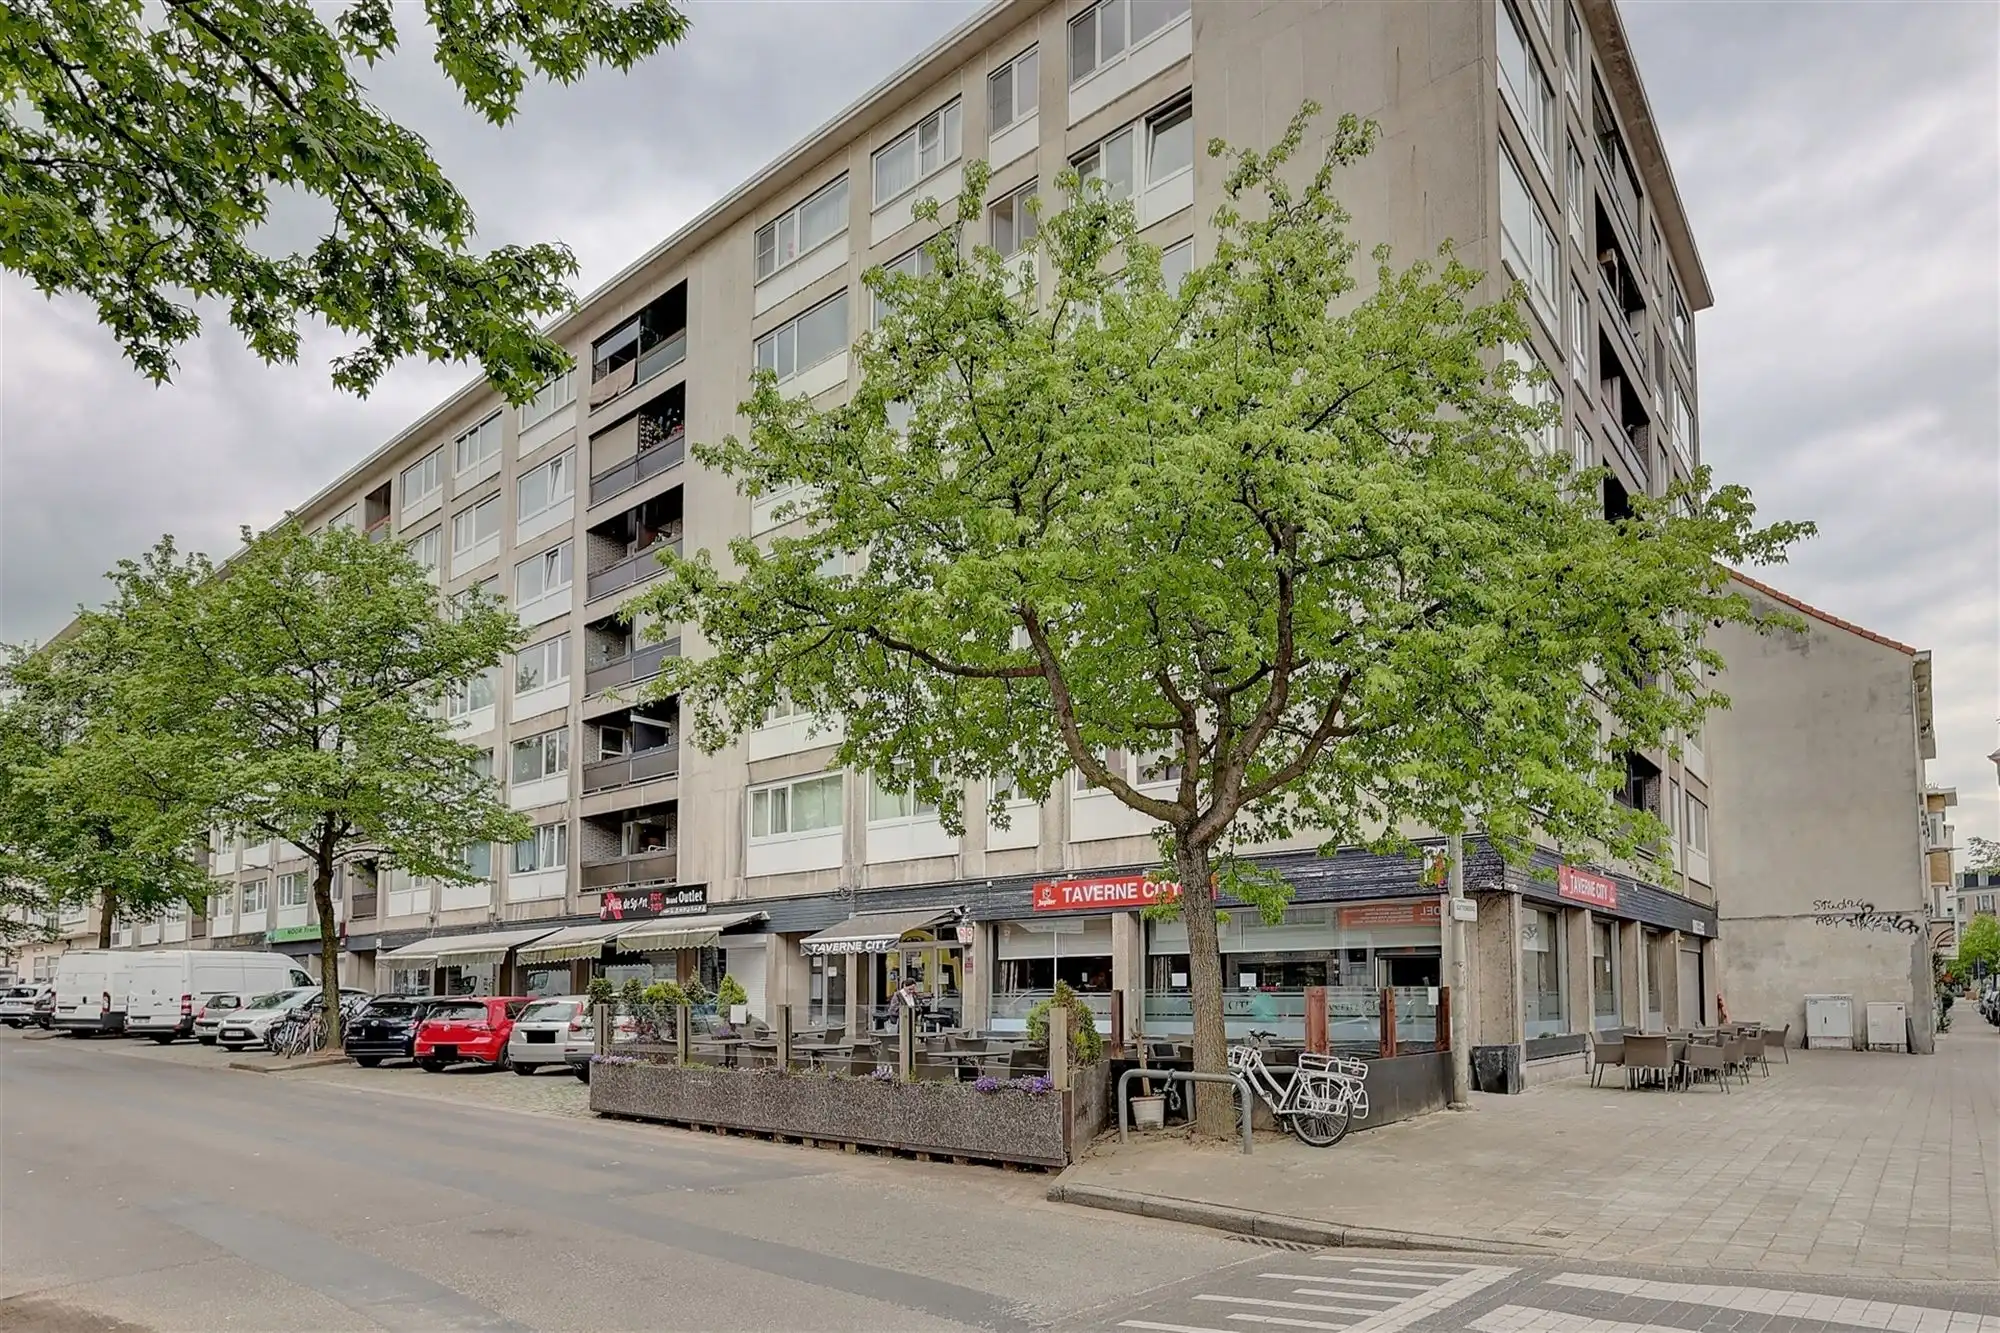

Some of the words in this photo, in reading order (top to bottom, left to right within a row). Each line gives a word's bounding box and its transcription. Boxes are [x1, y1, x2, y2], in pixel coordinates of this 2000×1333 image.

[679, 889, 703, 903] Outlet
[1062, 882, 1138, 903] TAVERNE
[1570, 875, 1596, 897] TAVERNE
[1596, 883, 1608, 900] CITY
[811, 941, 862, 953] TAVERNE
[865, 939, 889, 951] CITY
